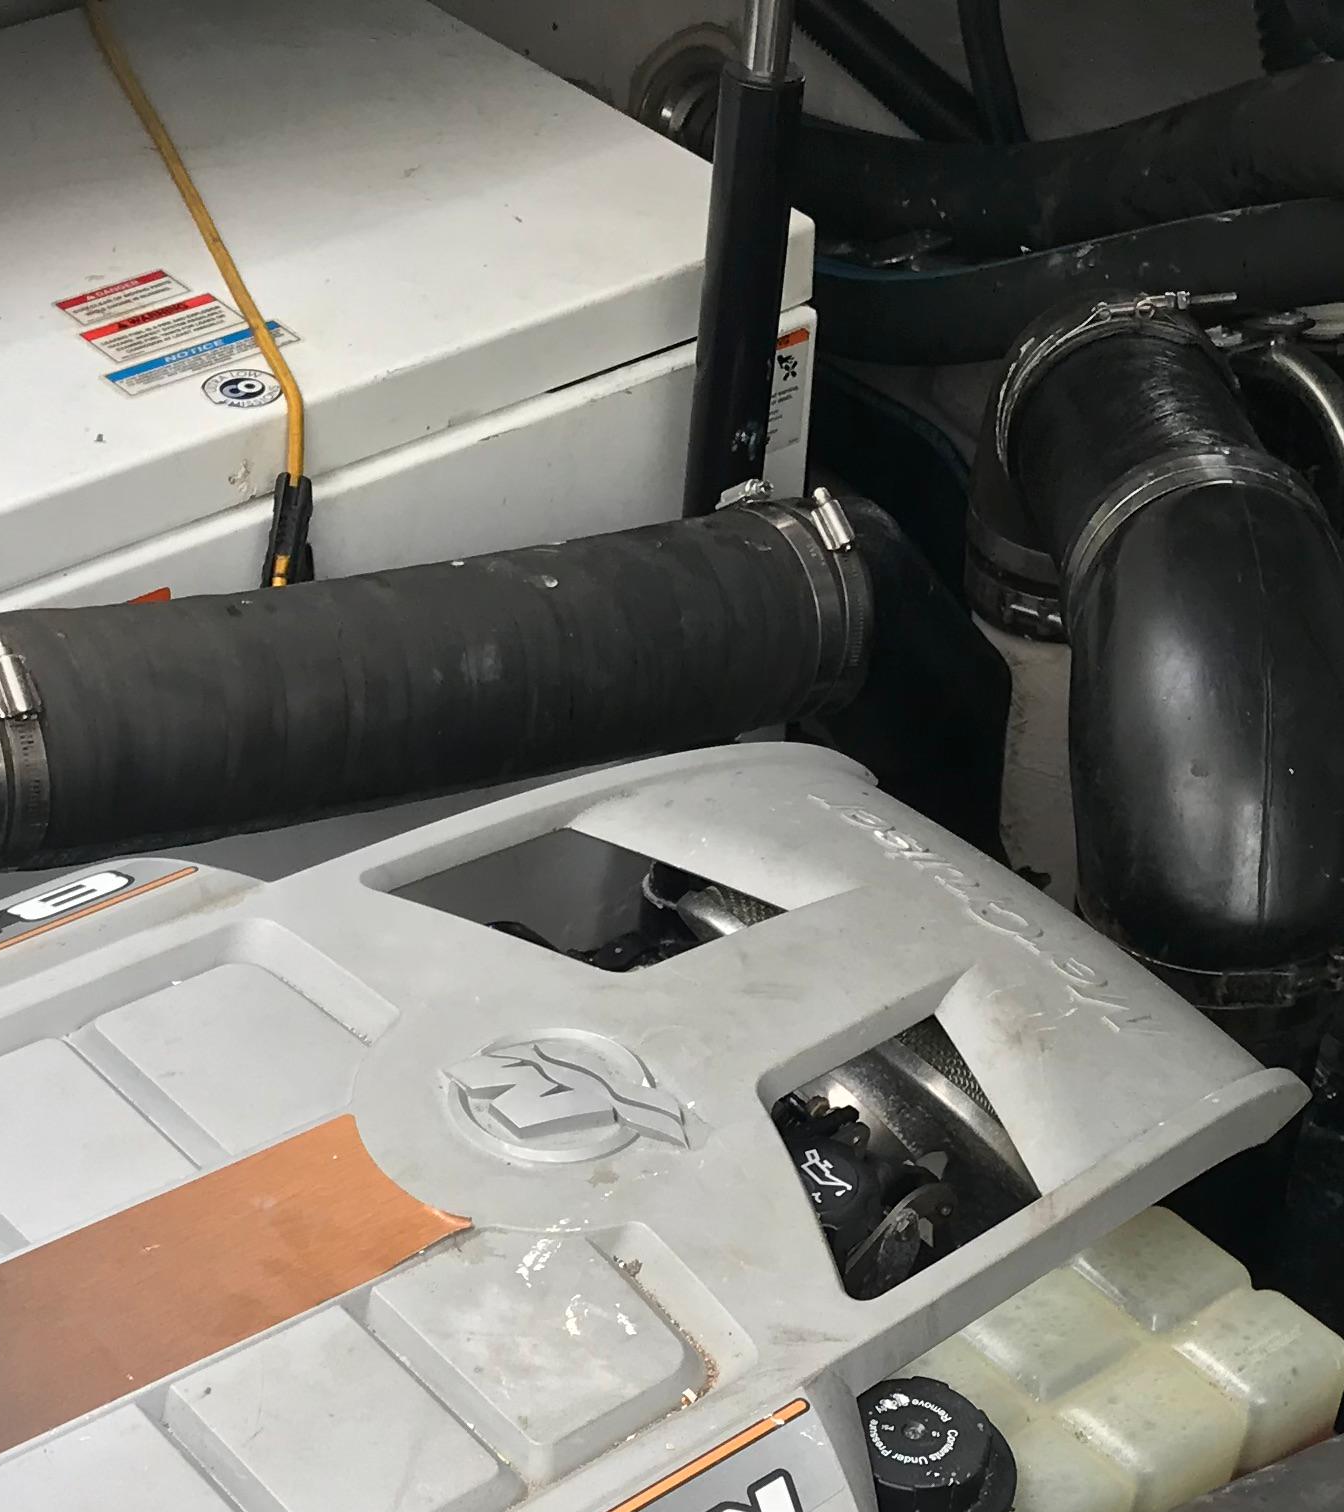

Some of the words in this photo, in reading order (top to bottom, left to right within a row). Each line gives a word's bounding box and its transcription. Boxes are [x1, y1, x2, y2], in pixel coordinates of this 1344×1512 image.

[164, 339, 225, 363] NOTICE
[911, 1399, 952, 1422] Remove
[869, 1419, 892, 1457] Pressure
[928, 1429, 958, 1461] Contents
[891, 1453, 929, 1465] Under
